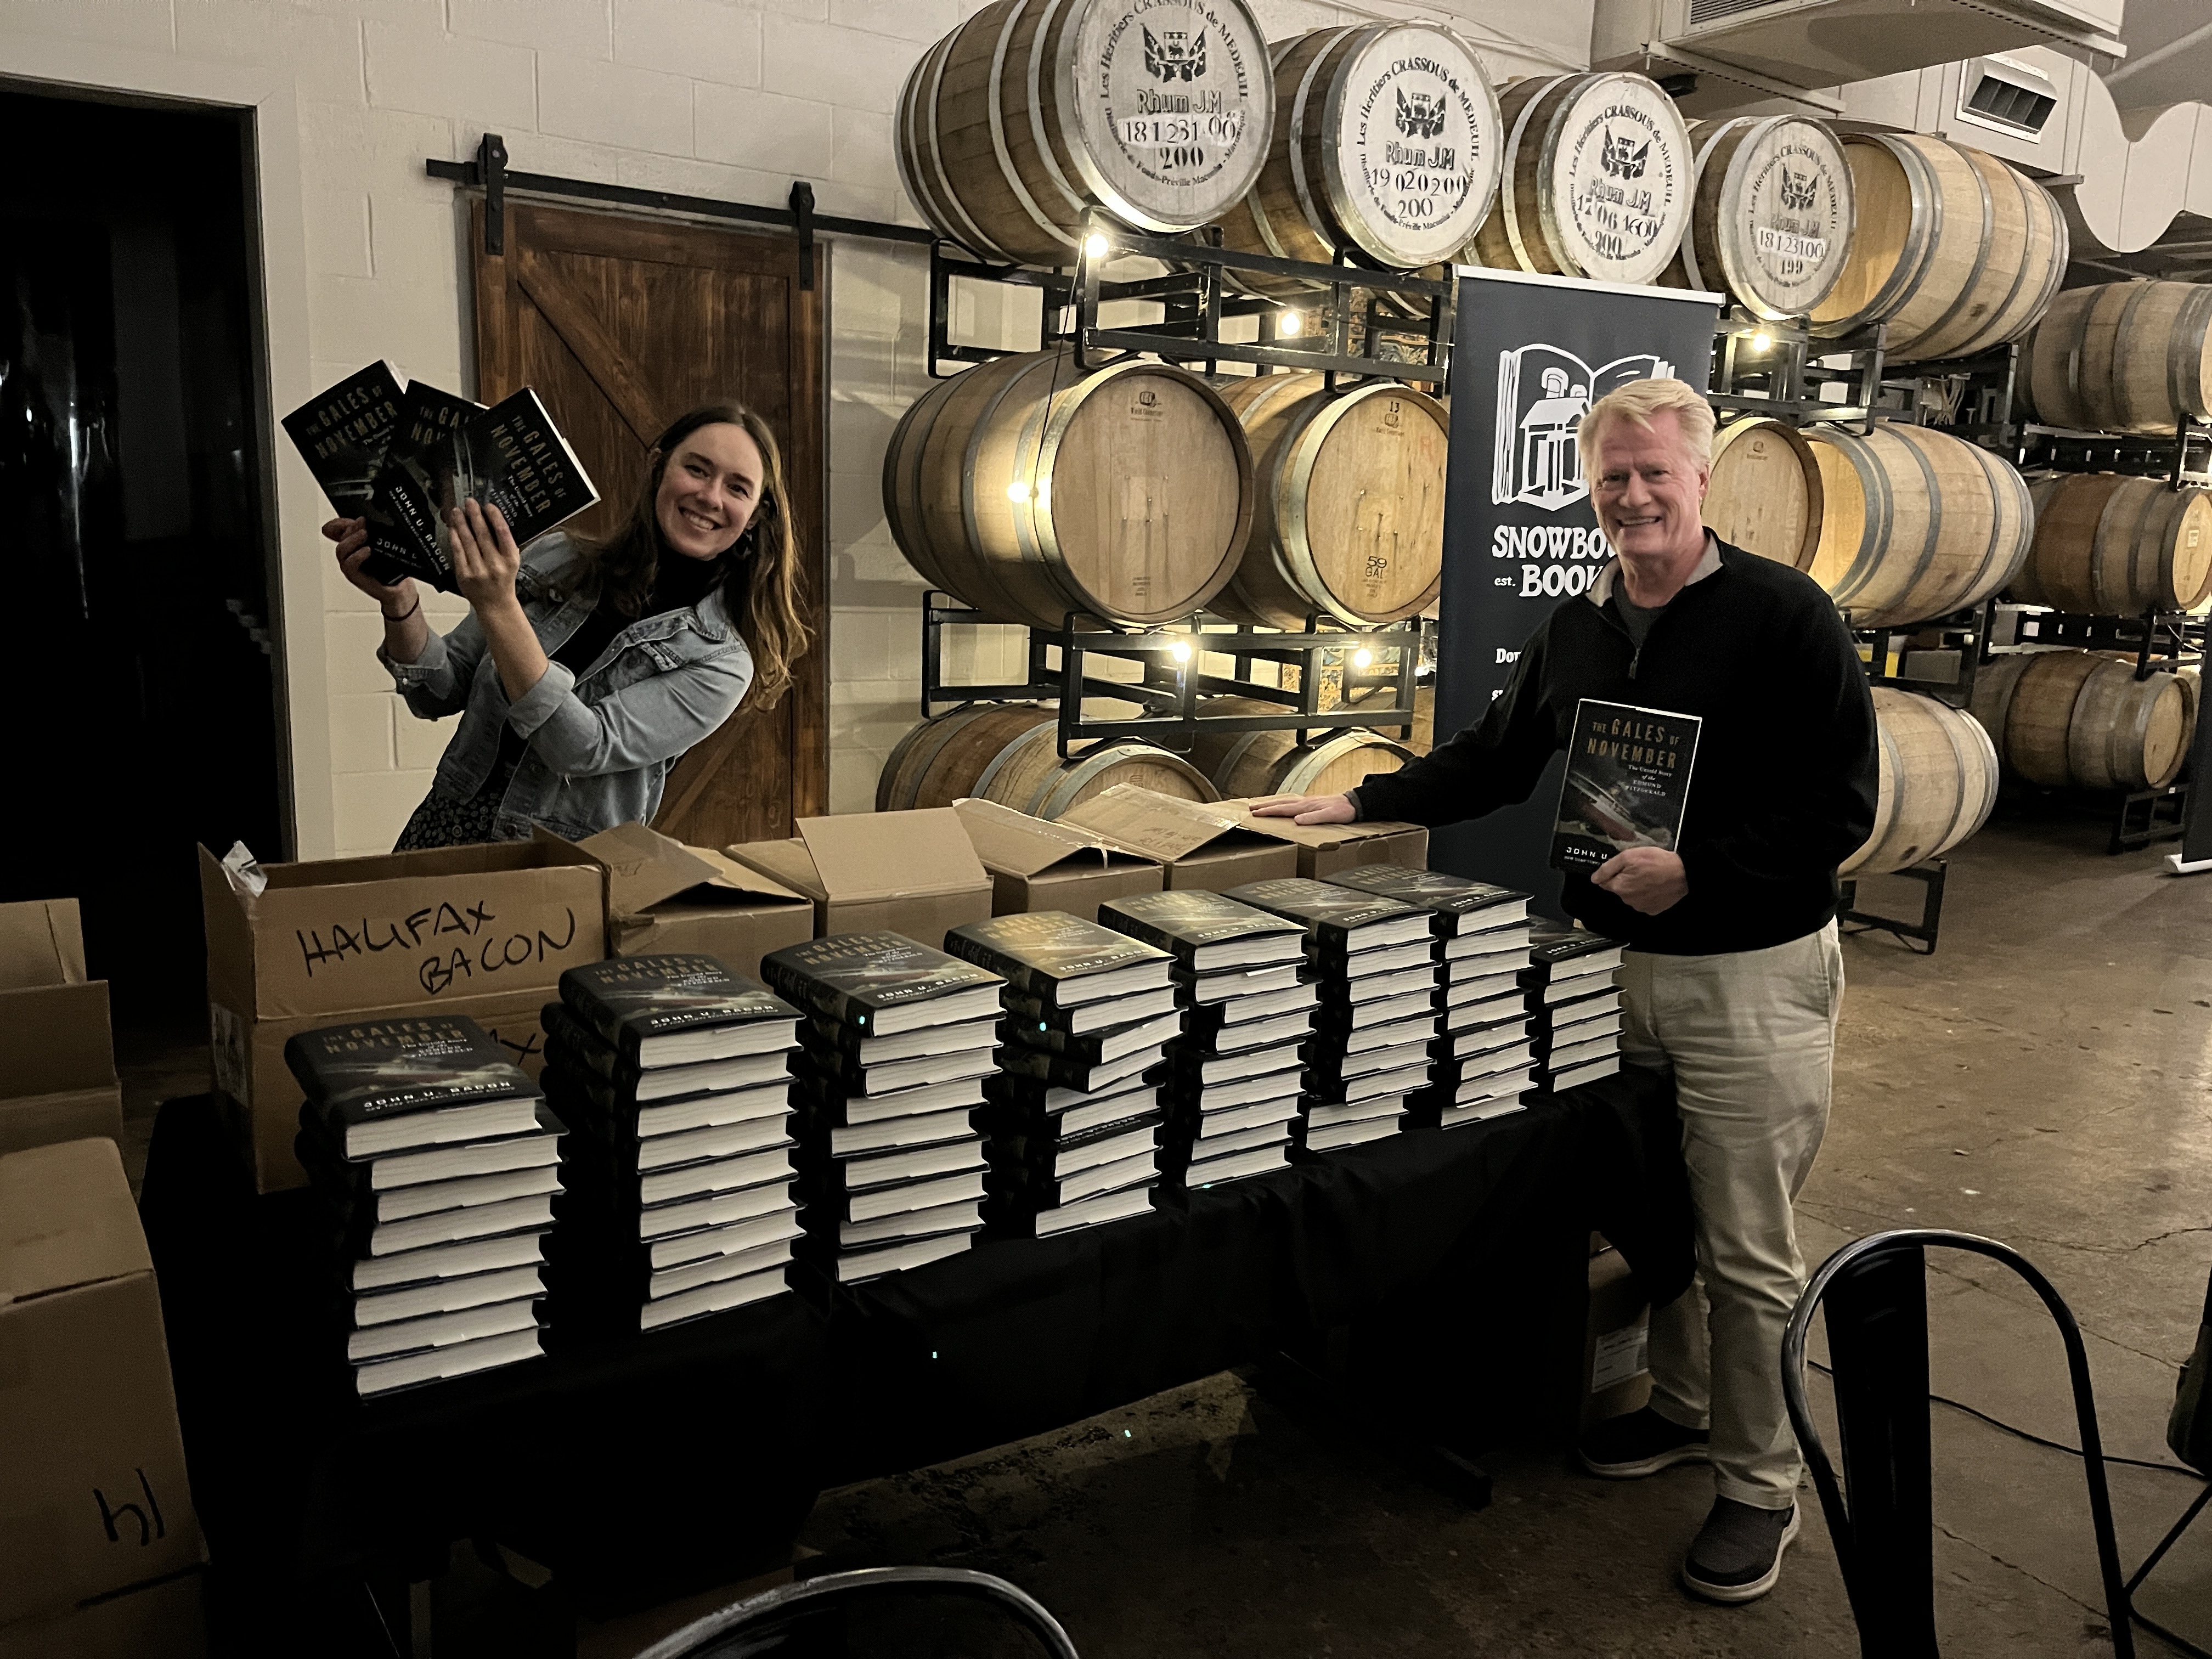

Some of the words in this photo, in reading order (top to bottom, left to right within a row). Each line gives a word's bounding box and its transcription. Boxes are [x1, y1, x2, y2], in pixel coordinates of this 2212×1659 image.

[1206, 10, 1218, 27] de
[1391, 57, 1449, 82] CRASSOUS
[1448, 78, 1460, 94] de
[1136, 88, 1189, 115] Rhum
[1604, 105, 1655, 132] CRASSOUS
[1652, 129, 1662, 144] de
[1160, 146, 1204, 170] 200
[1386, 140, 1425, 167] Rhum
[1398, 198, 1433, 219] 200
[1781, 259, 1803, 275] 199
[1389, 401, 1400, 413] 13
[490, 424, 551, 514] NOVEMBER
[522, 430, 564, 486] GALES
[395, 486, 417, 517] JOHN
[425, 533, 451, 572] BACON
[1365, 566, 1383, 579] GAL
[1367, 556, 1387, 568] 59
[1494, 577, 1516, 586] est.
[1592, 721, 1607, 733] THE
[1611, 718, 1665, 743] GALES
[1587, 737, 1677, 769] NOVEMBER
[1566, 847, 1596, 858] JOHN
[297, 900, 496, 978] HALIFAX
[419, 907, 576, 995] BACON
[812, 936, 873, 952] GALES
[616, 957, 686, 972] GALES
[804, 940, 906, 965] NOVEMBER
[600, 963, 719, 984] NOVEMBER
[325, 1029, 465, 1054] NOVEMBER
[351, 1022, 432, 1039] GALES
